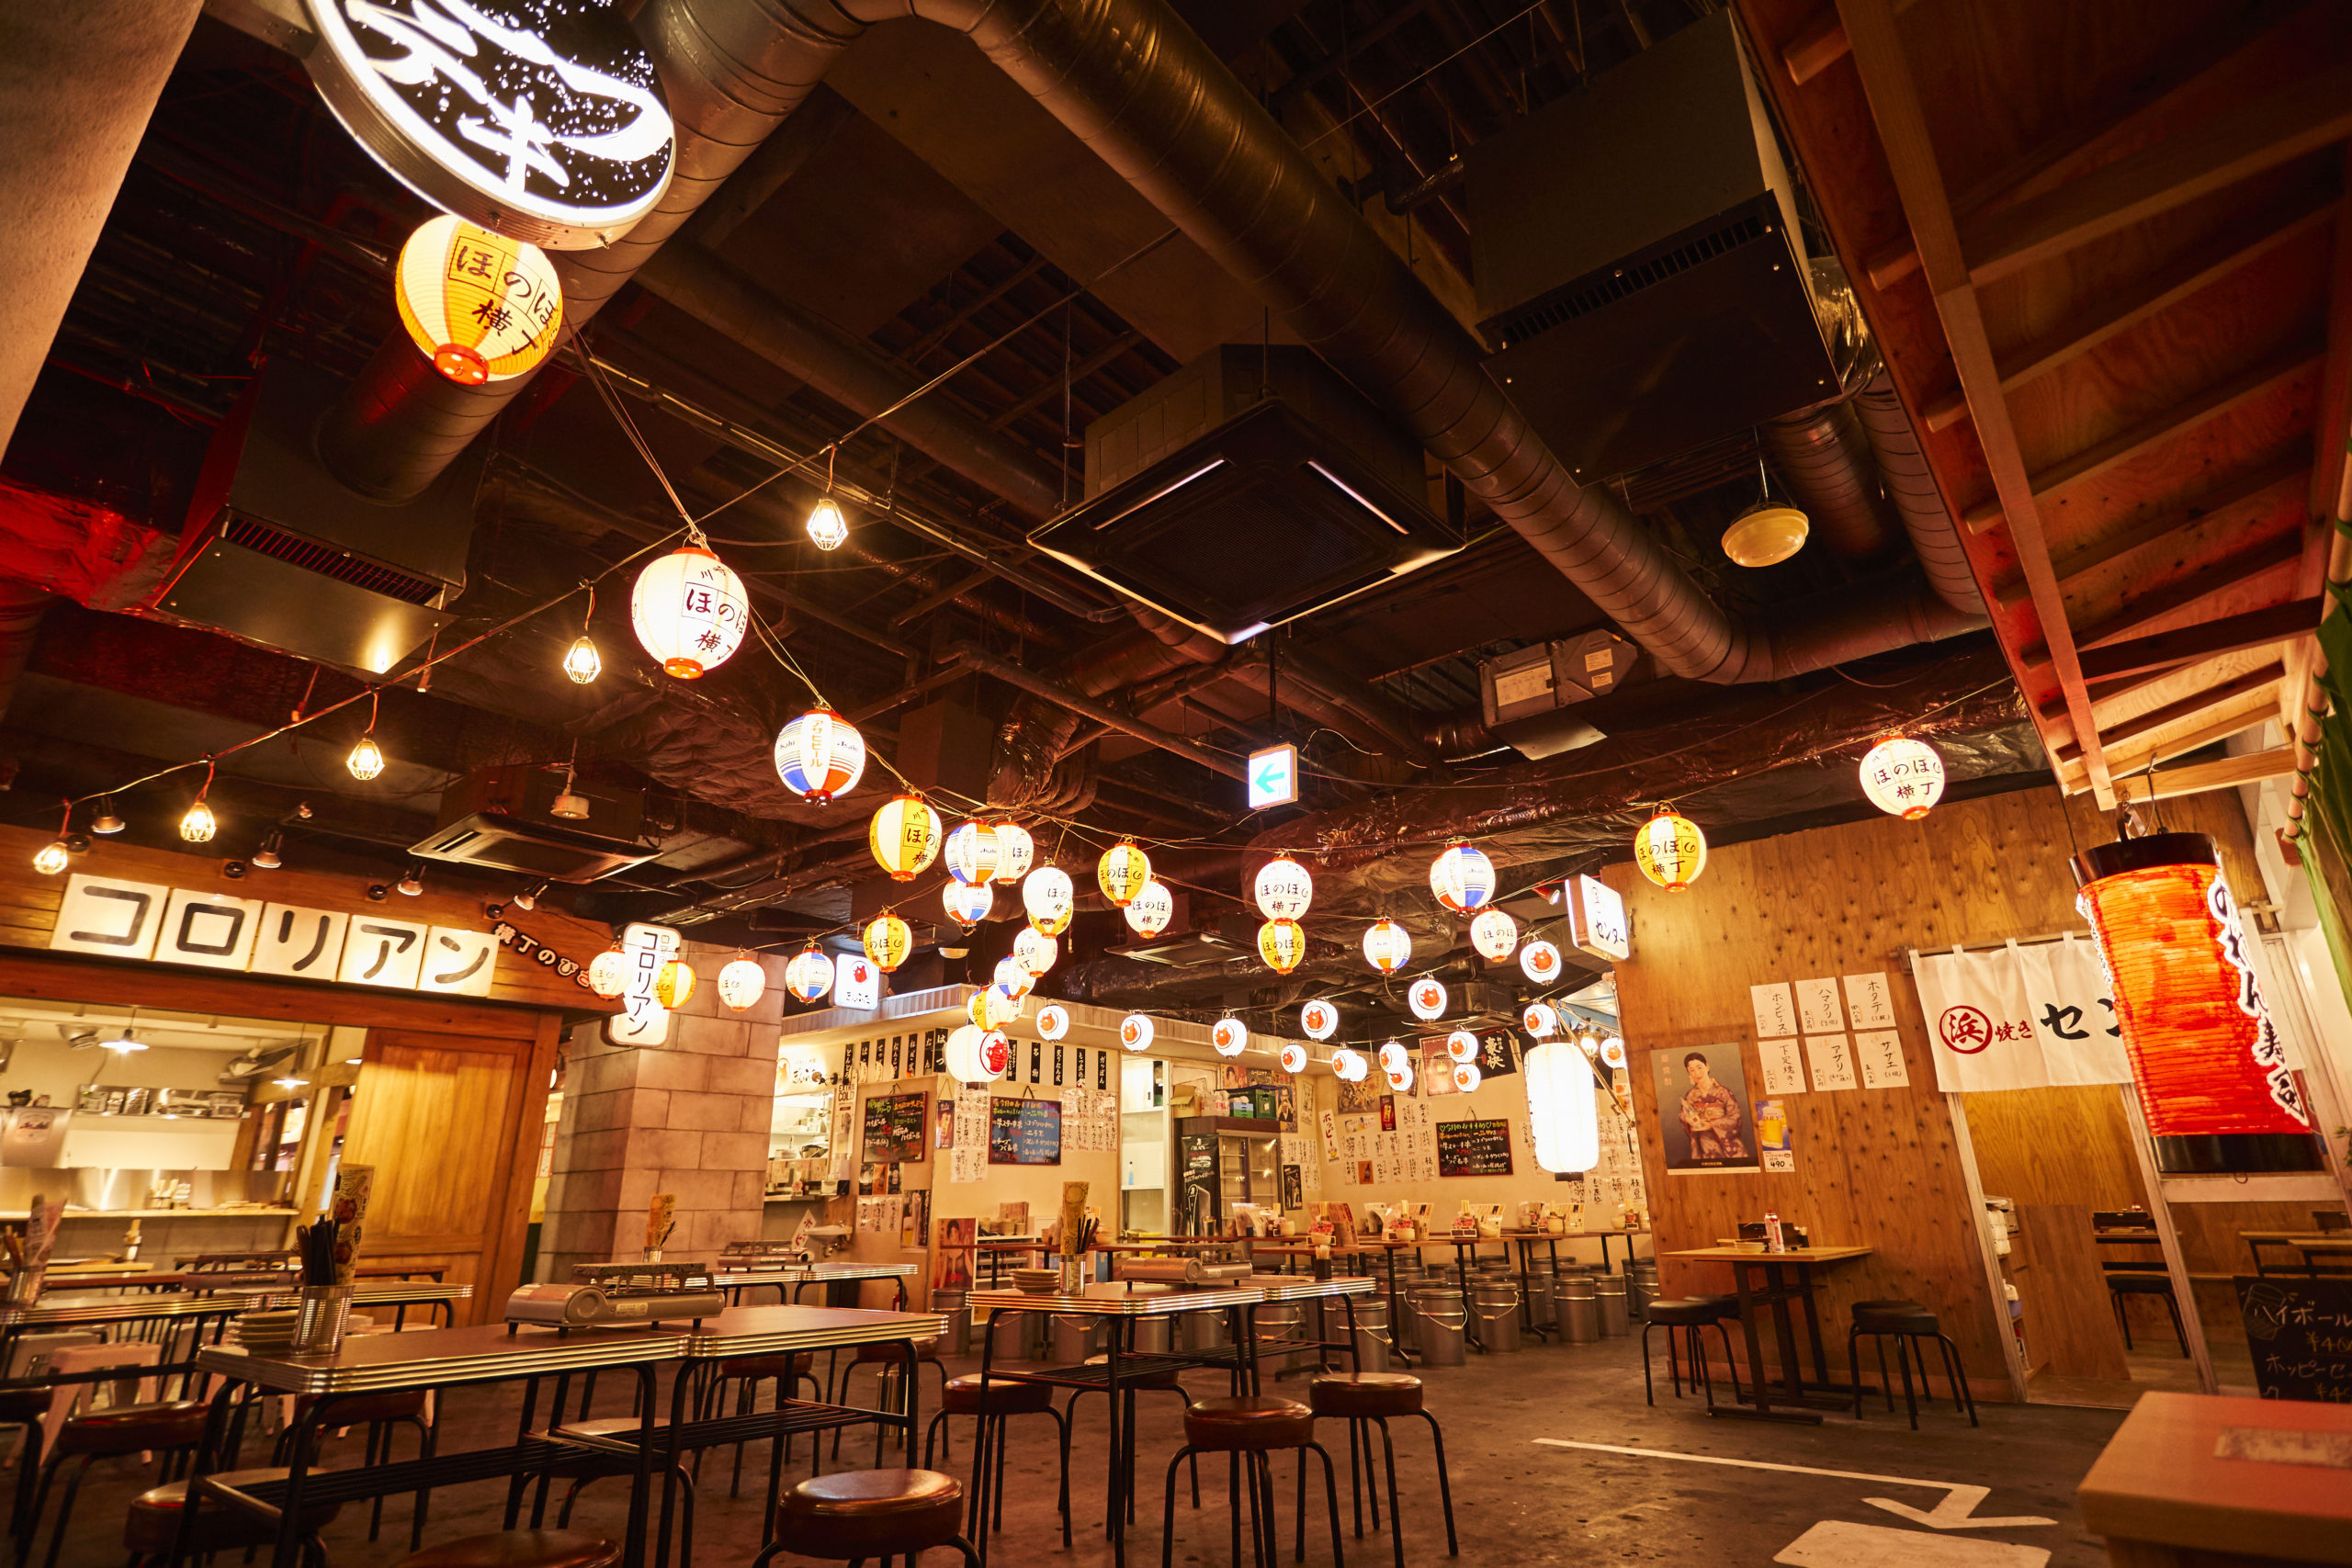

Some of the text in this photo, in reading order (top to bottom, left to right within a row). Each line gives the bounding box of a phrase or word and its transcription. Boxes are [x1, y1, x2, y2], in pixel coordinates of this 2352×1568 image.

[472, 299, 538, 355] 横丁
[695, 630, 733, 661] 横丁
[809, 719, 823, 768] アサヒビール
[1896, 782, 1935, 798] 横丁
[1652, 860, 1686, 876] 横丁
[1272, 901, 1301, 912] 横丁
[69, 885, 491, 985] コロリアン
[1141, 915, 1167, 927] 横丁
[1595, 919, 1625, 944] センター
[628, 931, 658, 1036] コロリアン
[1867, 980, 1882, 1013] ホタテ
[1818, 987, 1833, 1020] ハマグリ
[1946, 1010, 2033, 1047] 浜焼き
[1485, 1036, 1506, 1070] 豪快
[1831, 1044, 1844, 1072] アサリ
[1881, 1041, 1898, 1069] サザエ
[838, 1091, 854, 1102] COLD
[1323, 1112, 1333, 1147] ホッピー
[1770, 1160, 1785, 1168] 490
[2254, 1300, 2352, 1327] ハイボール
[2266, 1352, 2352, 1379] ホッピーセ
